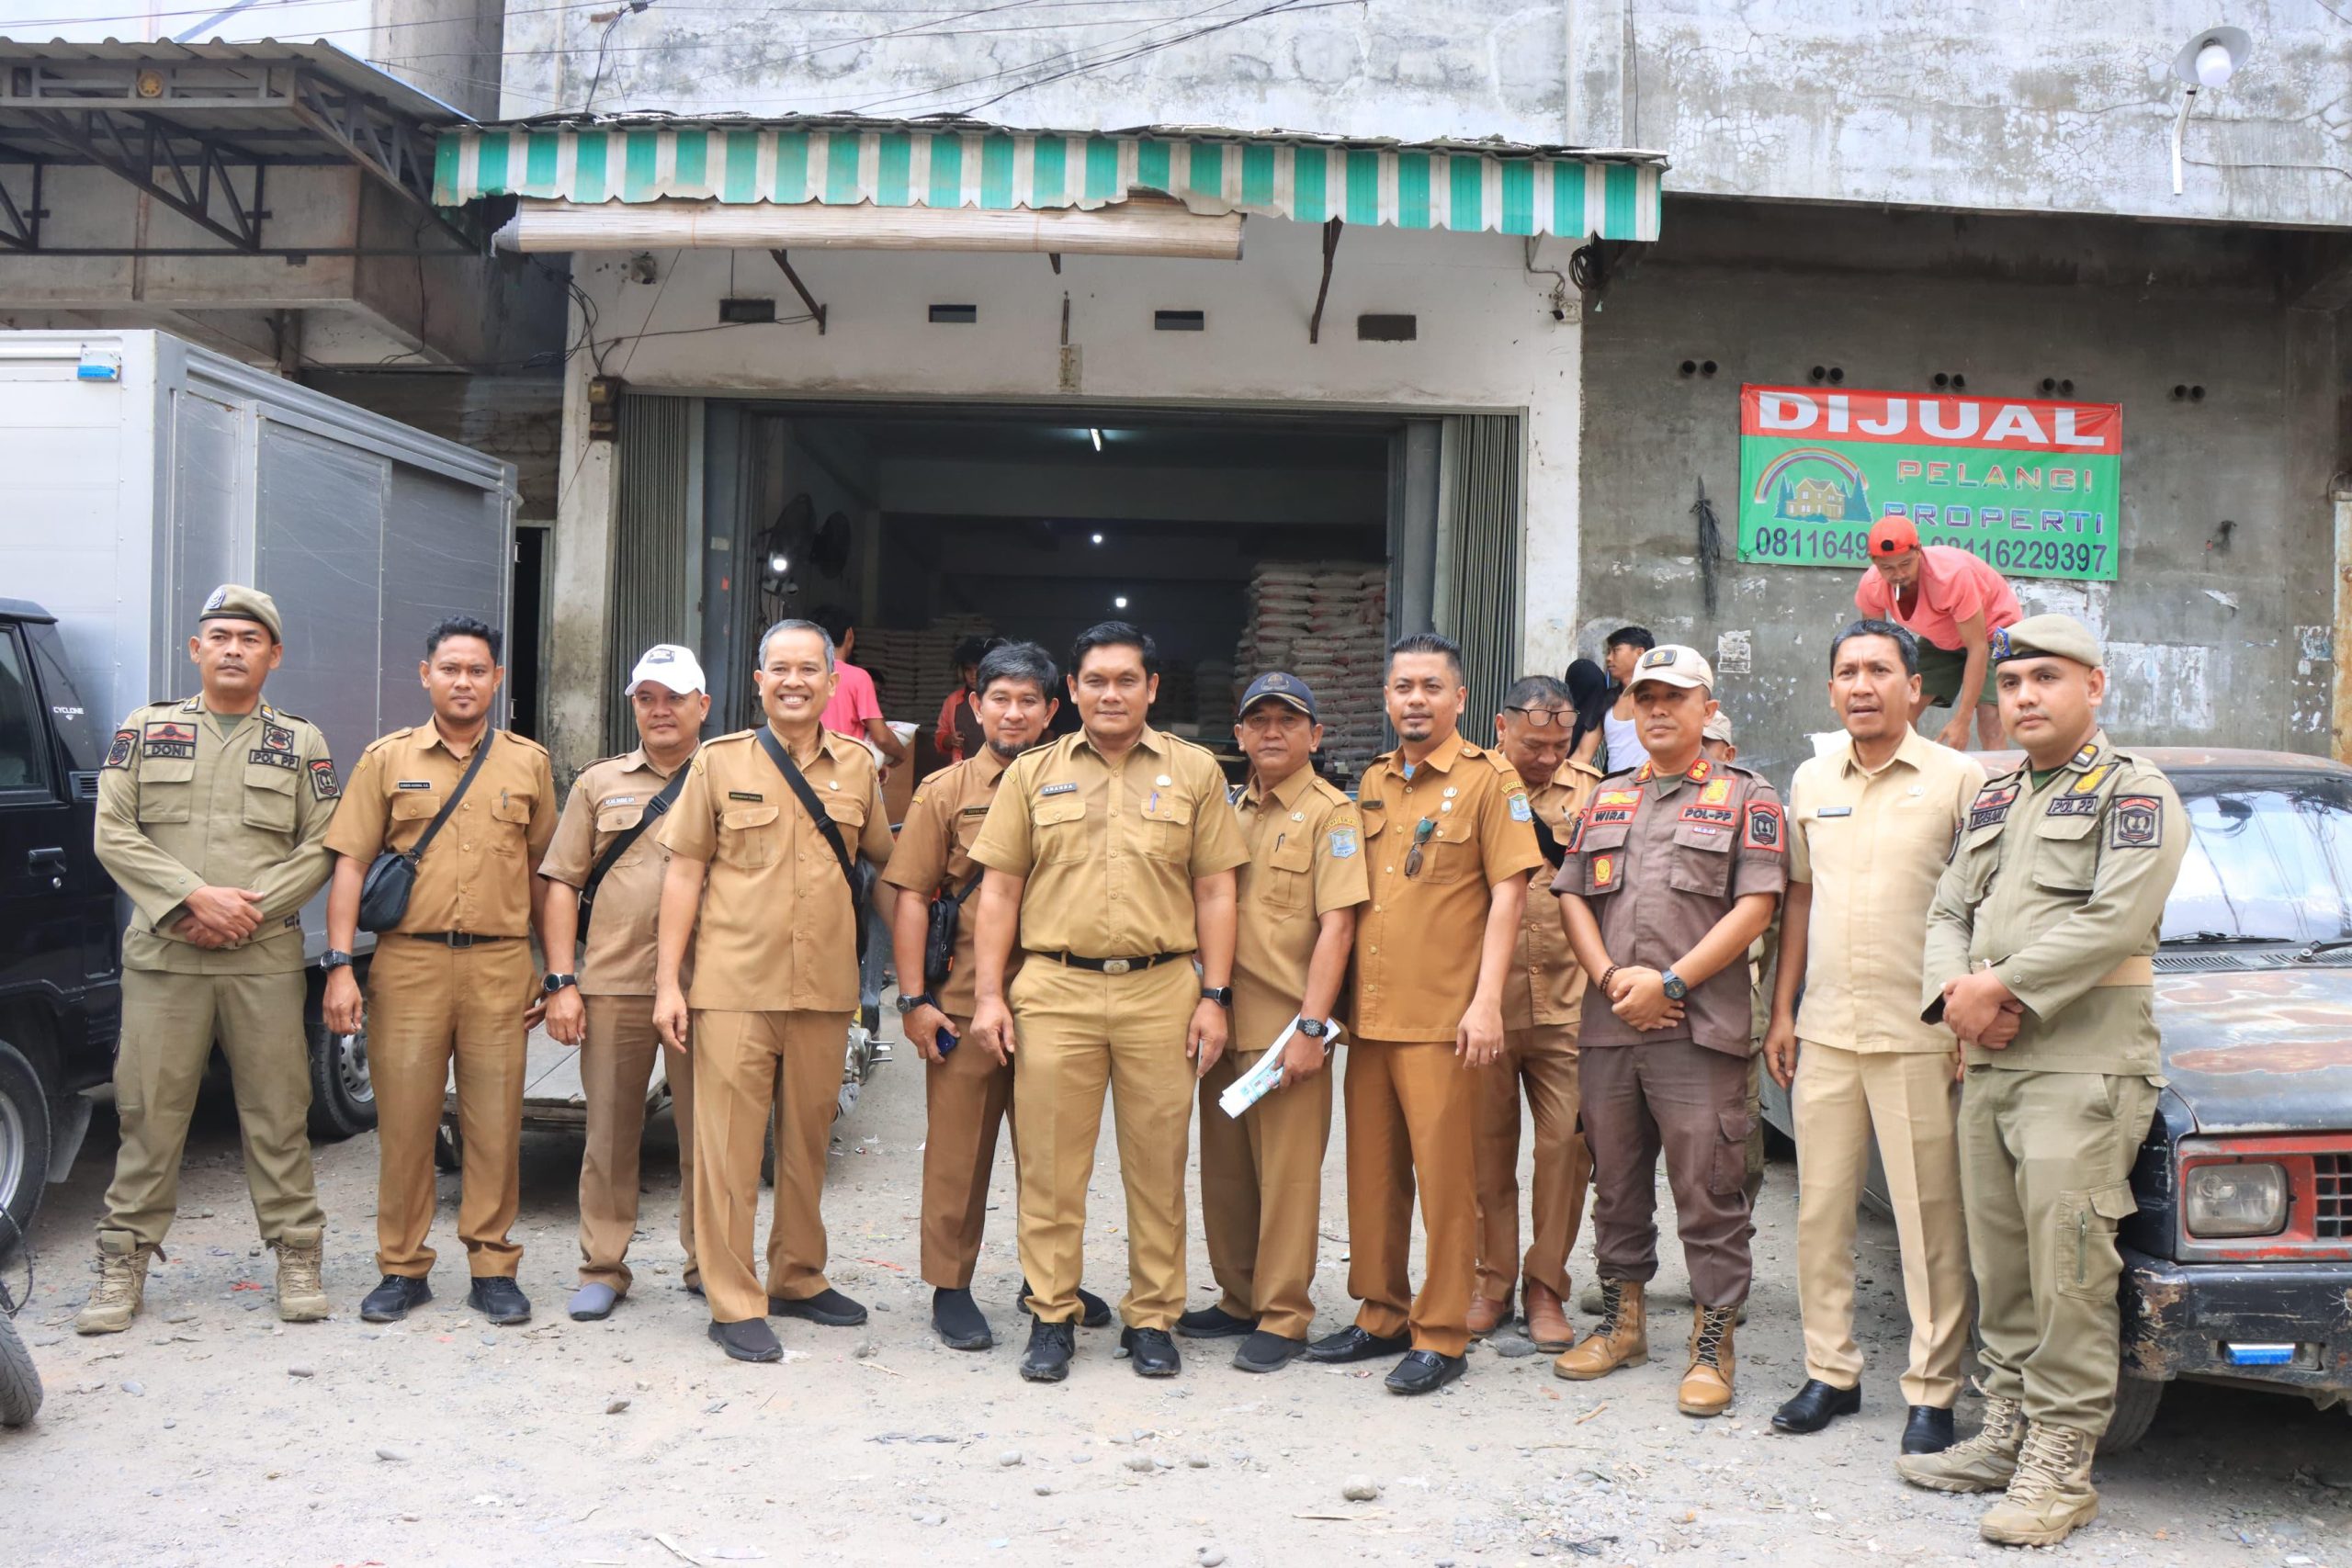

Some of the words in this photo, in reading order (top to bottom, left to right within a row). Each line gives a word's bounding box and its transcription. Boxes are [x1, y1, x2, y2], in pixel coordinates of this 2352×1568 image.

[1758, 390, 2105, 446] DIJUAL
[1896, 459, 2093, 493] PELANGI
[1883, 502, 2104, 536] PROPERTI
[1756, 526, 1870, 560] 0811649
[53, 706, 85, 715] CYCLONE
[152, 745, 187, 757] DONI
[254, 753, 276, 764] POL
[281, 755, 296, 767] PP
[2052, 798, 2073, 812] POL
[2077, 798, 2095, 811] PP
[1595, 809, 1626, 822] WIRA
[1684, 807, 1732, 820] POL-PP
